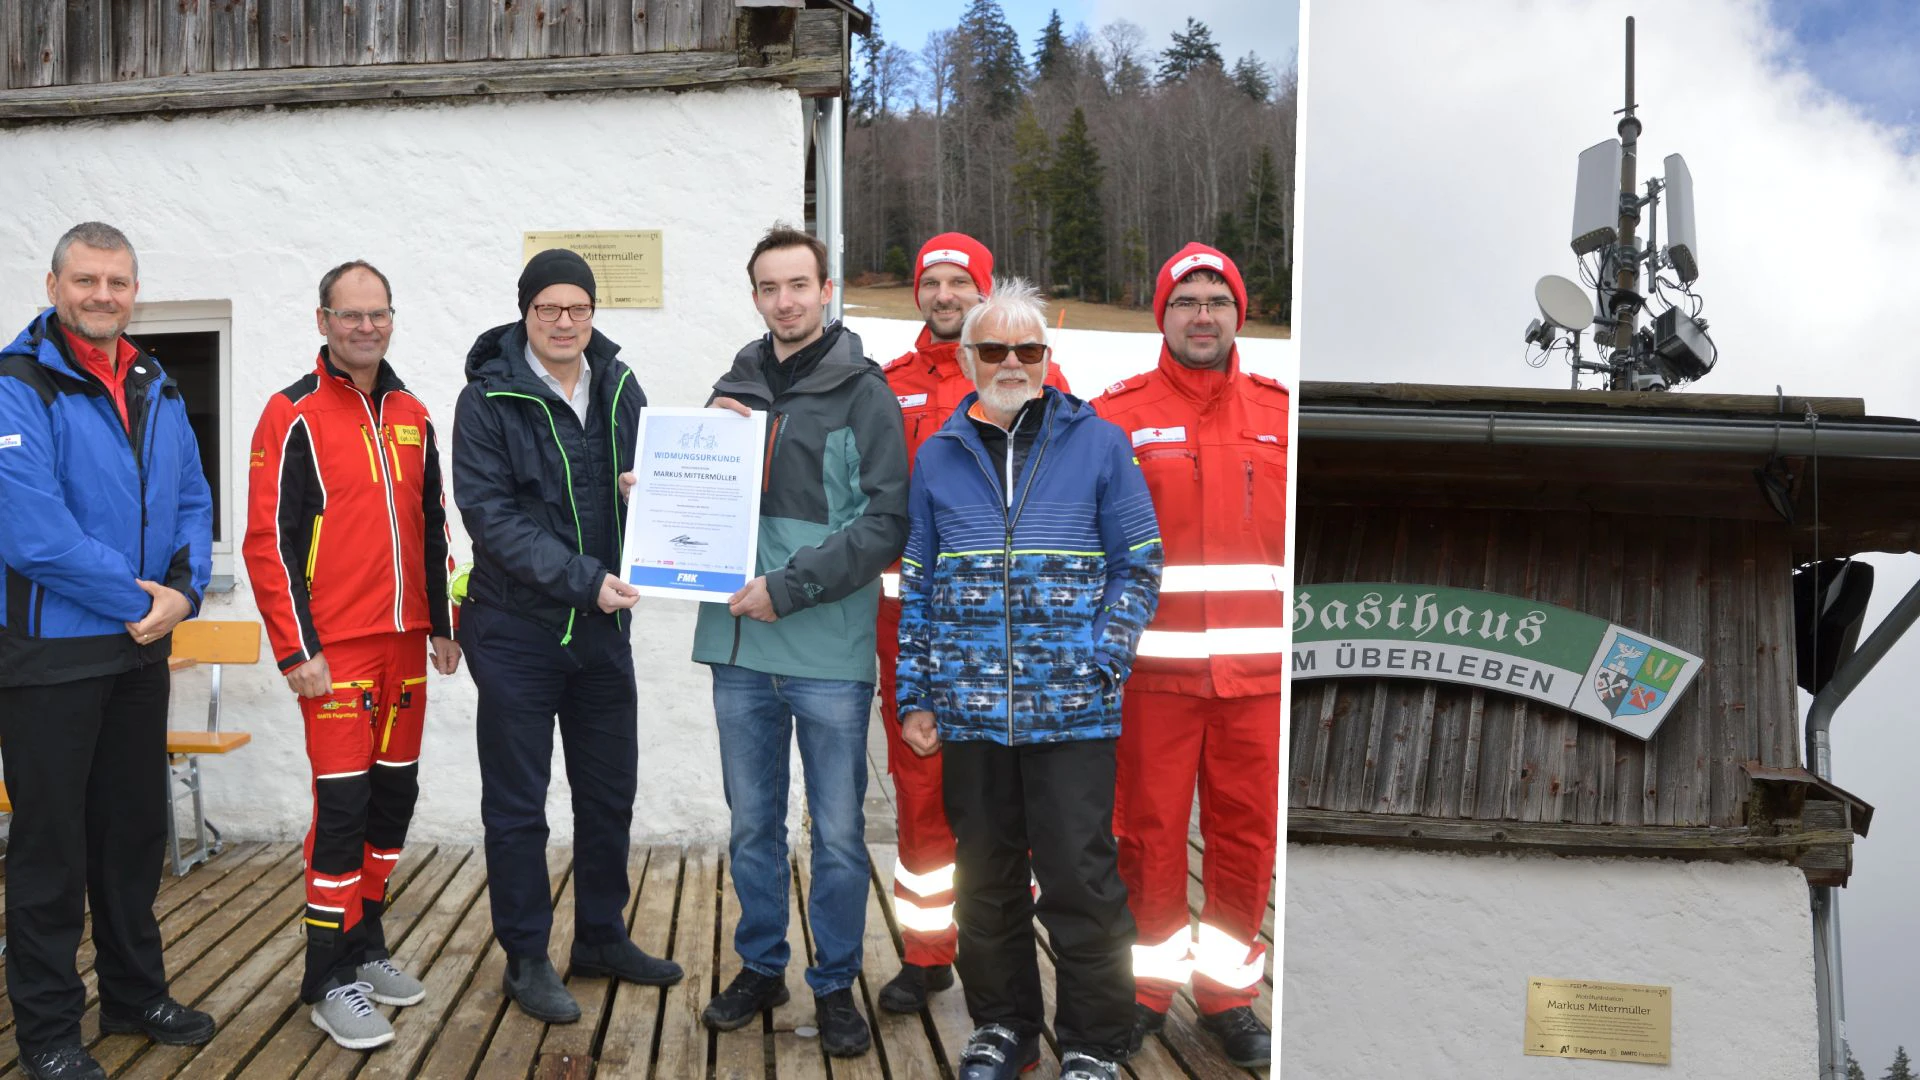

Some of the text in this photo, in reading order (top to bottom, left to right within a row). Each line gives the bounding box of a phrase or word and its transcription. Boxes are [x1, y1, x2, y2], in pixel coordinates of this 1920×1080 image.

[582, 251, 644, 262] Mittermüller
[654, 451, 741, 463] WIDMUNGSURKUNDE
[653, 470, 737, 481] MARKUS MITTERMÜLLER
[676, 572, 699, 583] FMK
[1336, 642, 1555, 694] ÜBERLEBEN
[1546, 999, 1651, 1015] Markus Mittermüller
[1580, 1047, 1607, 1056] Magenta
